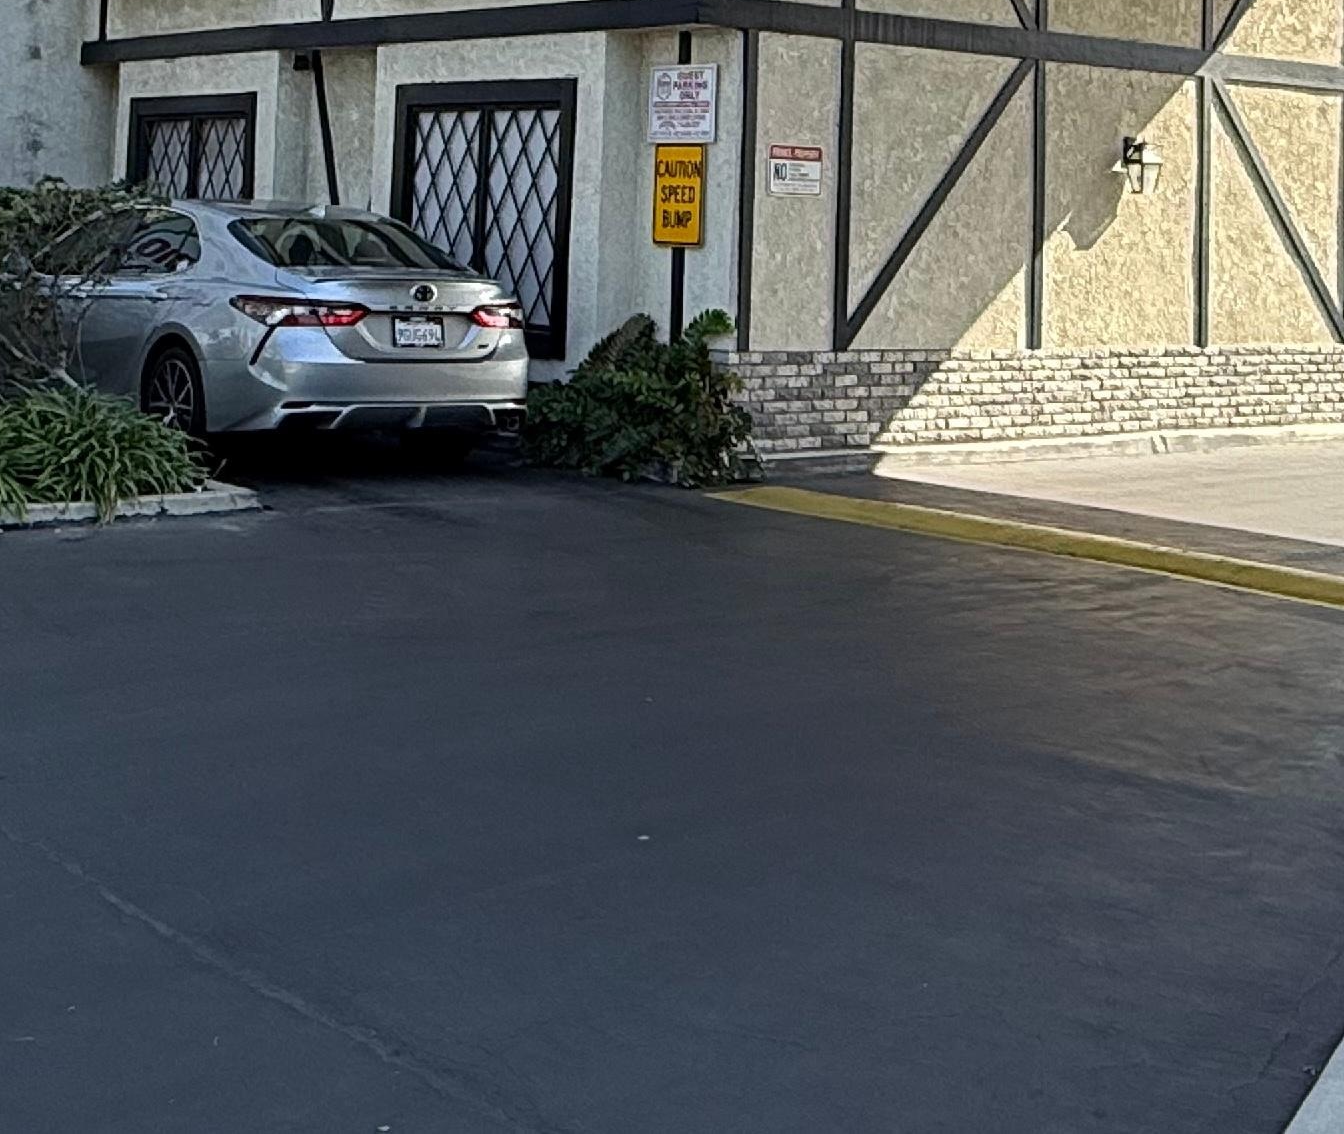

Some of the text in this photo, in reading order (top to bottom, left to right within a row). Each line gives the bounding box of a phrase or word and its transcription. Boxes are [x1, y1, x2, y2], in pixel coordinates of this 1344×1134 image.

[657, 160, 703, 178] CAUTION
[661, 185, 696, 203] SPEED
[662, 209, 693, 228] BUMP
